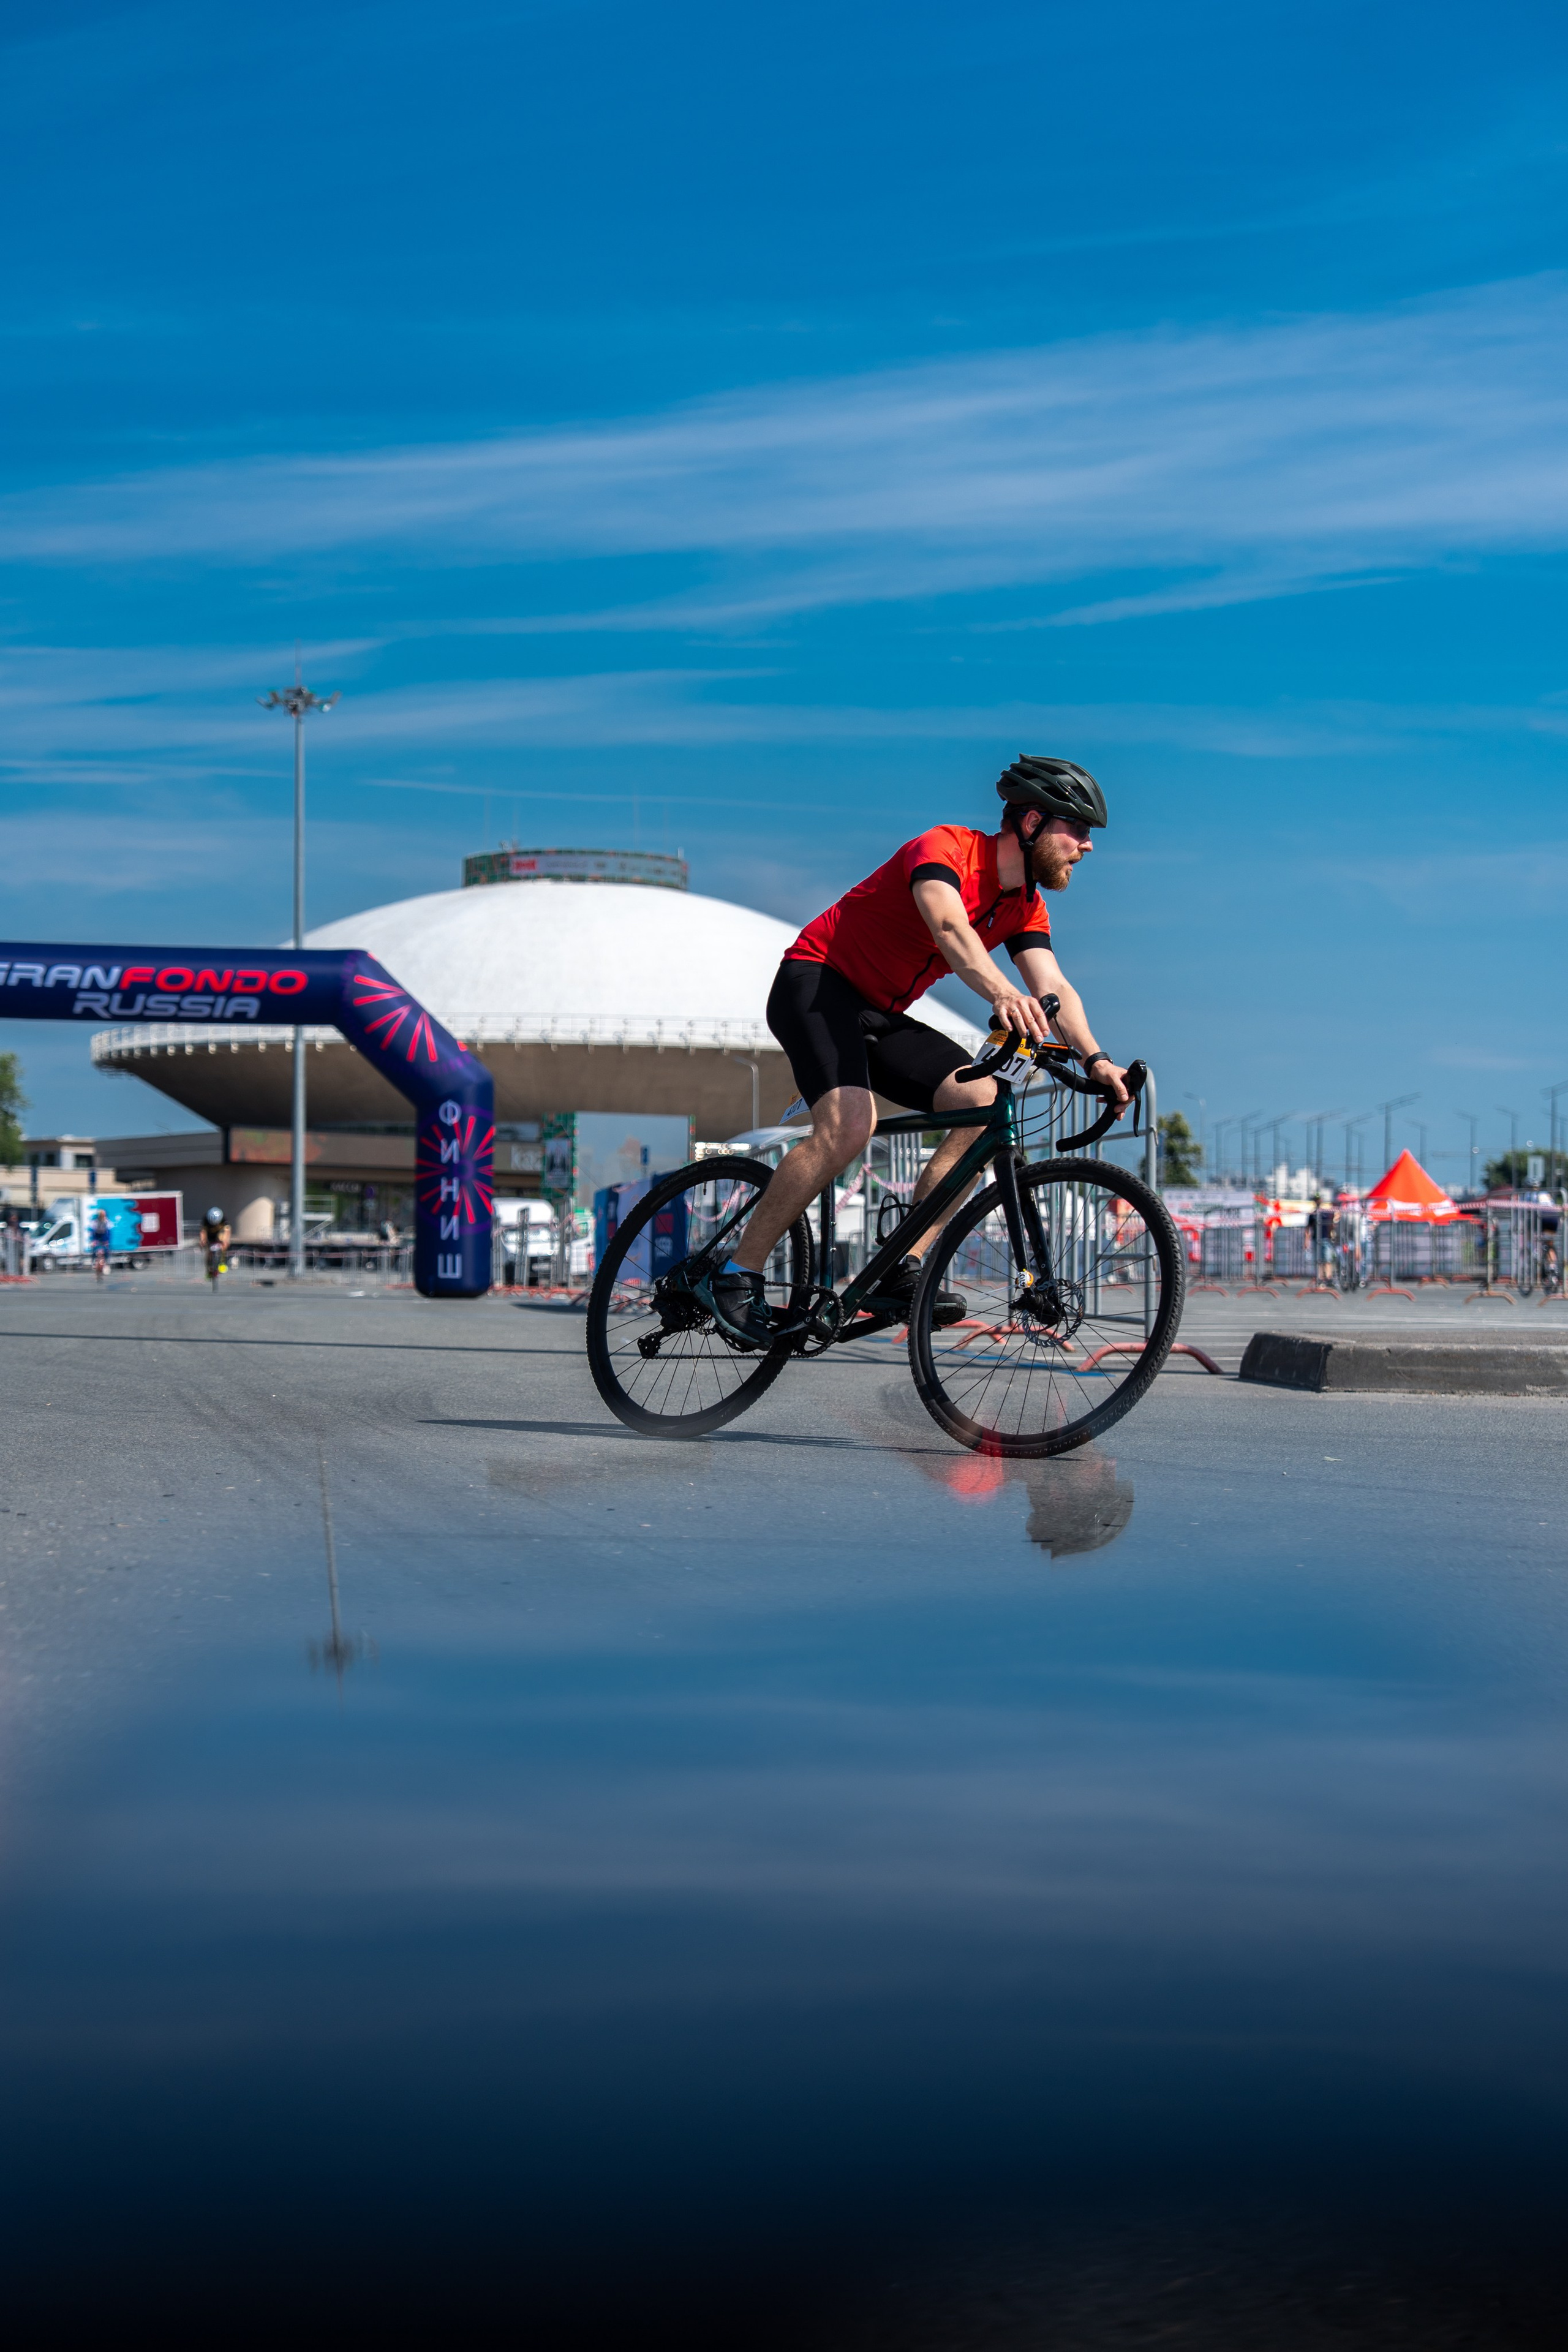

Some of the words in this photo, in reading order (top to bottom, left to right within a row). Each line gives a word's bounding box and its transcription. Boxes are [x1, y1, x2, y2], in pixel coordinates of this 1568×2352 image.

[73, 992, 261, 1018] RUSSIA
[981, 1047, 1026, 1076] 407
[786, 1098, 802, 1116] 4107
[659, 1166, 698, 1191] SCHWALBE
[1028, 1165, 1043, 1174] CX
[437, 1099, 462, 1278] ФИНИШ
